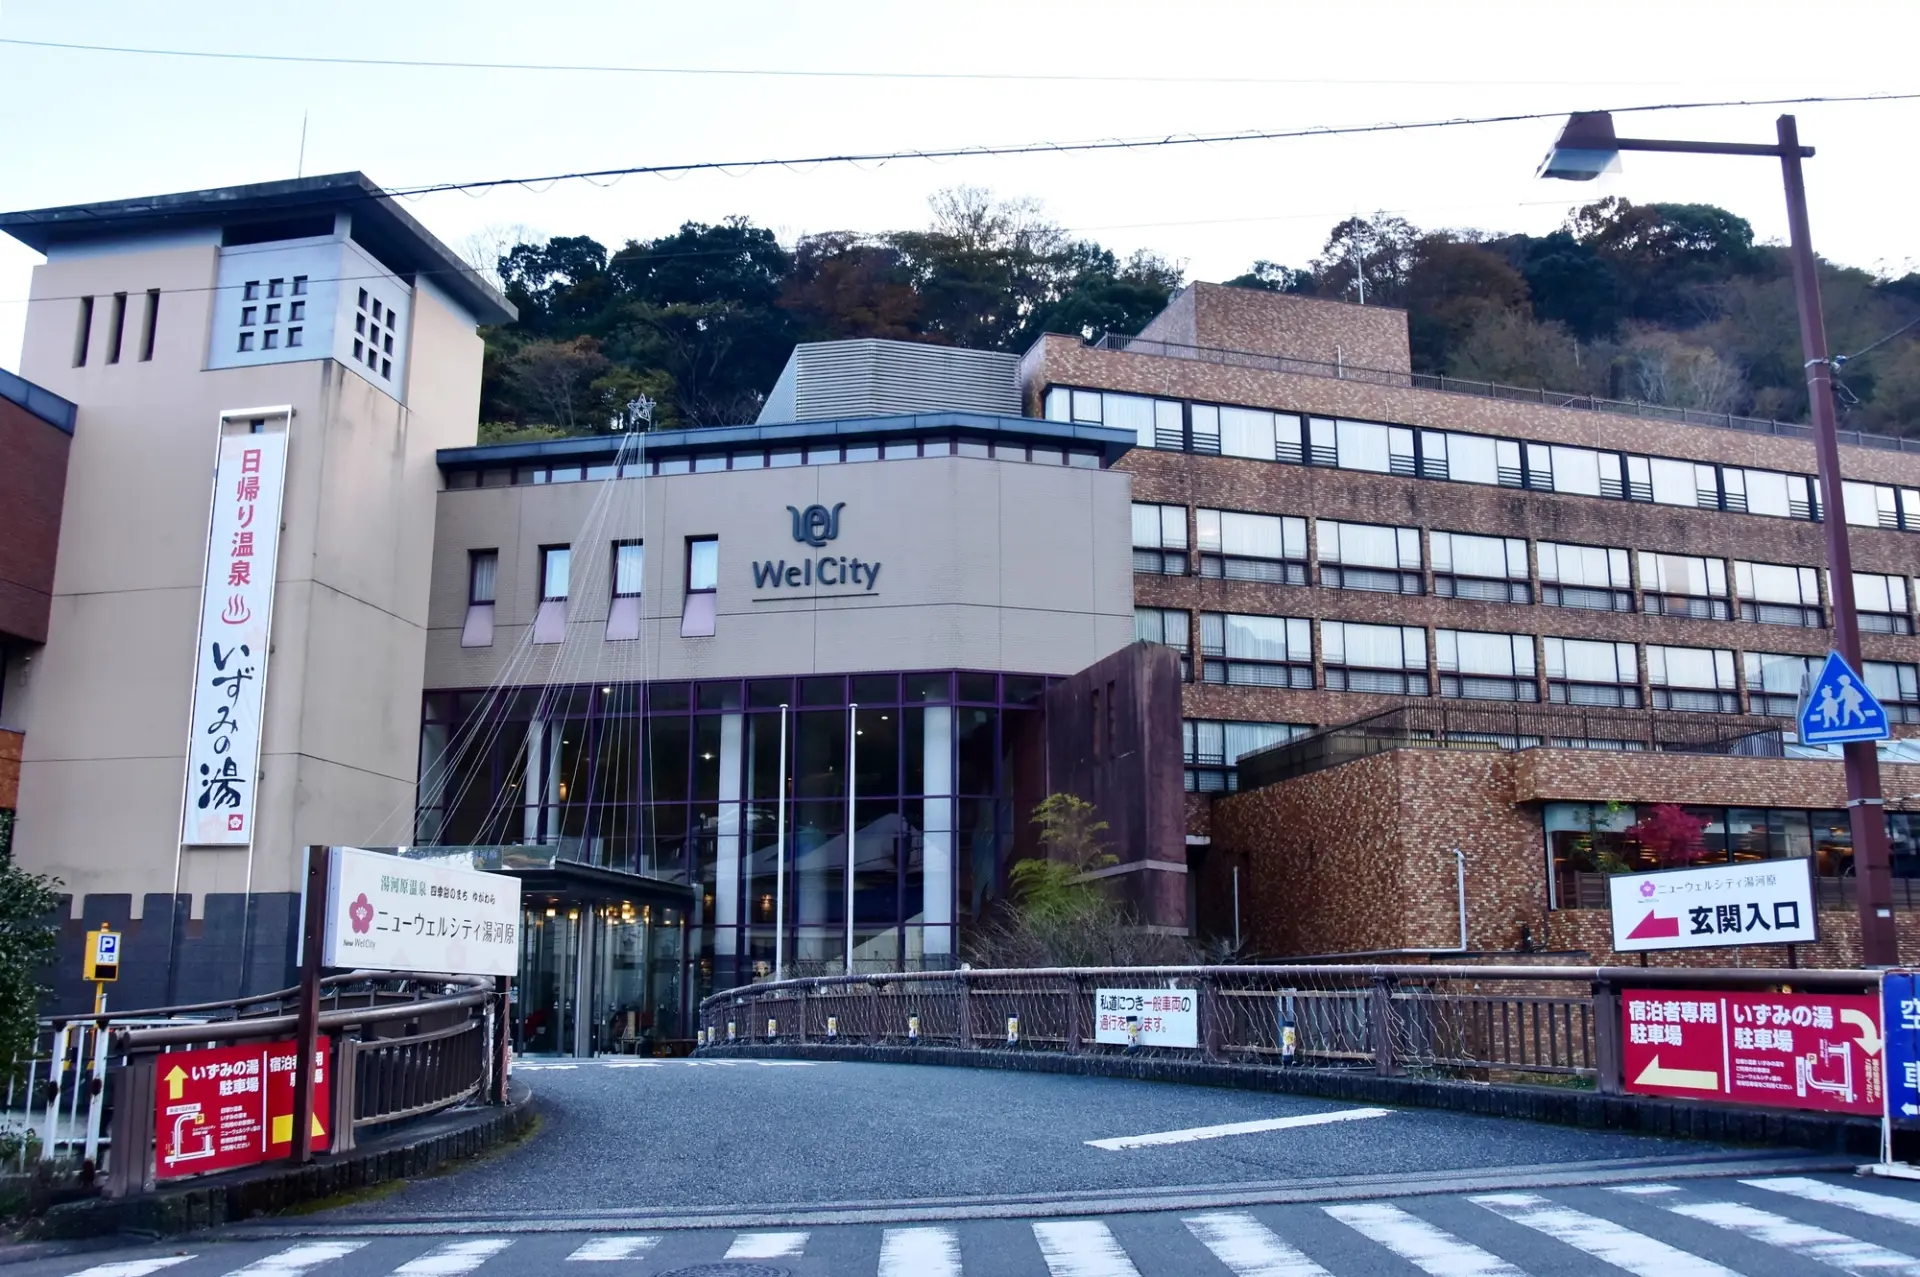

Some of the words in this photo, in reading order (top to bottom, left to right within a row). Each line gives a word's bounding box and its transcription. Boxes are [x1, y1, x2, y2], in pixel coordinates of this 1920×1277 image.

[227, 448, 262, 587] 日帰り温泉
[752, 556, 882, 591] WelCity
[198, 641, 256, 811] いずみの湯
[381, 874, 427, 897] 湯河原温泉
[472, 889, 496, 905] ゆがわら
[1658, 874, 1778, 895] ニューウェルシティ湯河原
[376, 910, 515, 944] ニューウェルシティ湯河原
[1688, 901, 1800, 935] 玄関入口
[101, 937, 114, 952] P
[1100, 994, 1191, 1012] 私道につき一般車両の
[1629, 1000, 1717, 1025] 宿泊者専用
[1733, 1003, 1834, 1030] いずみの湯
[1630, 1024, 1683, 1047] 駐車場
[1734, 1027, 1794, 1053] 駐車場
[192, 1059, 260, 1081] いずみの湯
[219, 1077, 260, 1097] 駐車場
